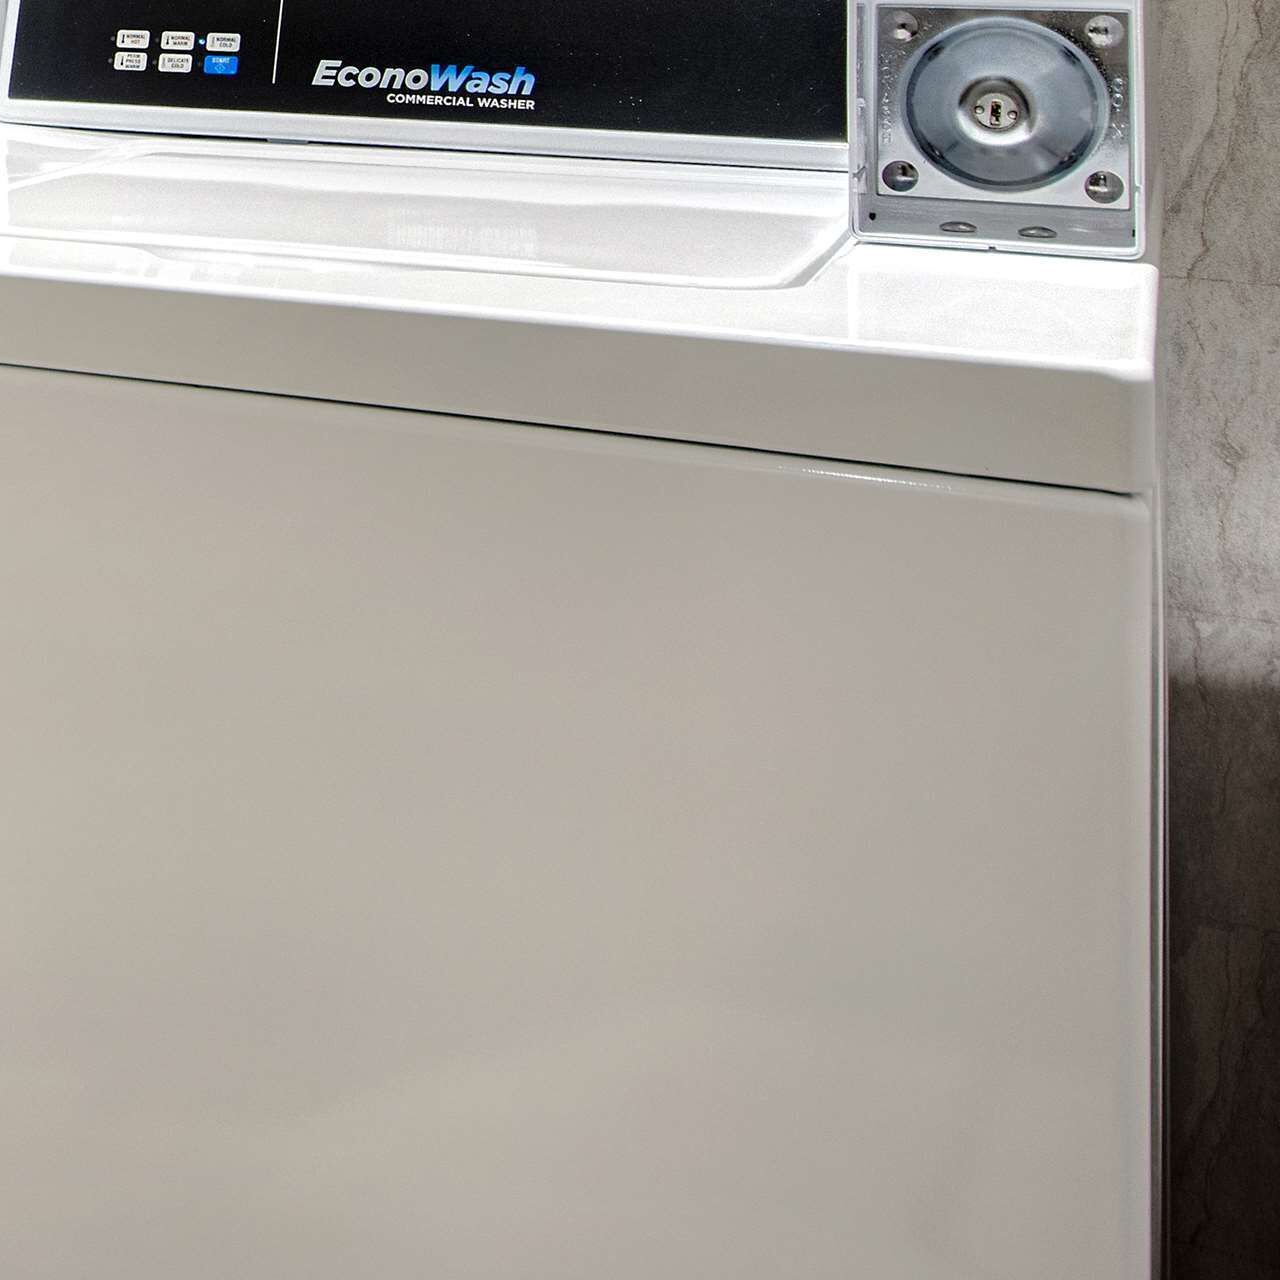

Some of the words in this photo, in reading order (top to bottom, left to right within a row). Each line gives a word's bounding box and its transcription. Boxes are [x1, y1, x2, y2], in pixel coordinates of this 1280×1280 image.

[311, 59, 536, 96] EconoWash
[386, 93, 474, 108] COMMERCIAL
[477, 97, 536, 111] WASHER
